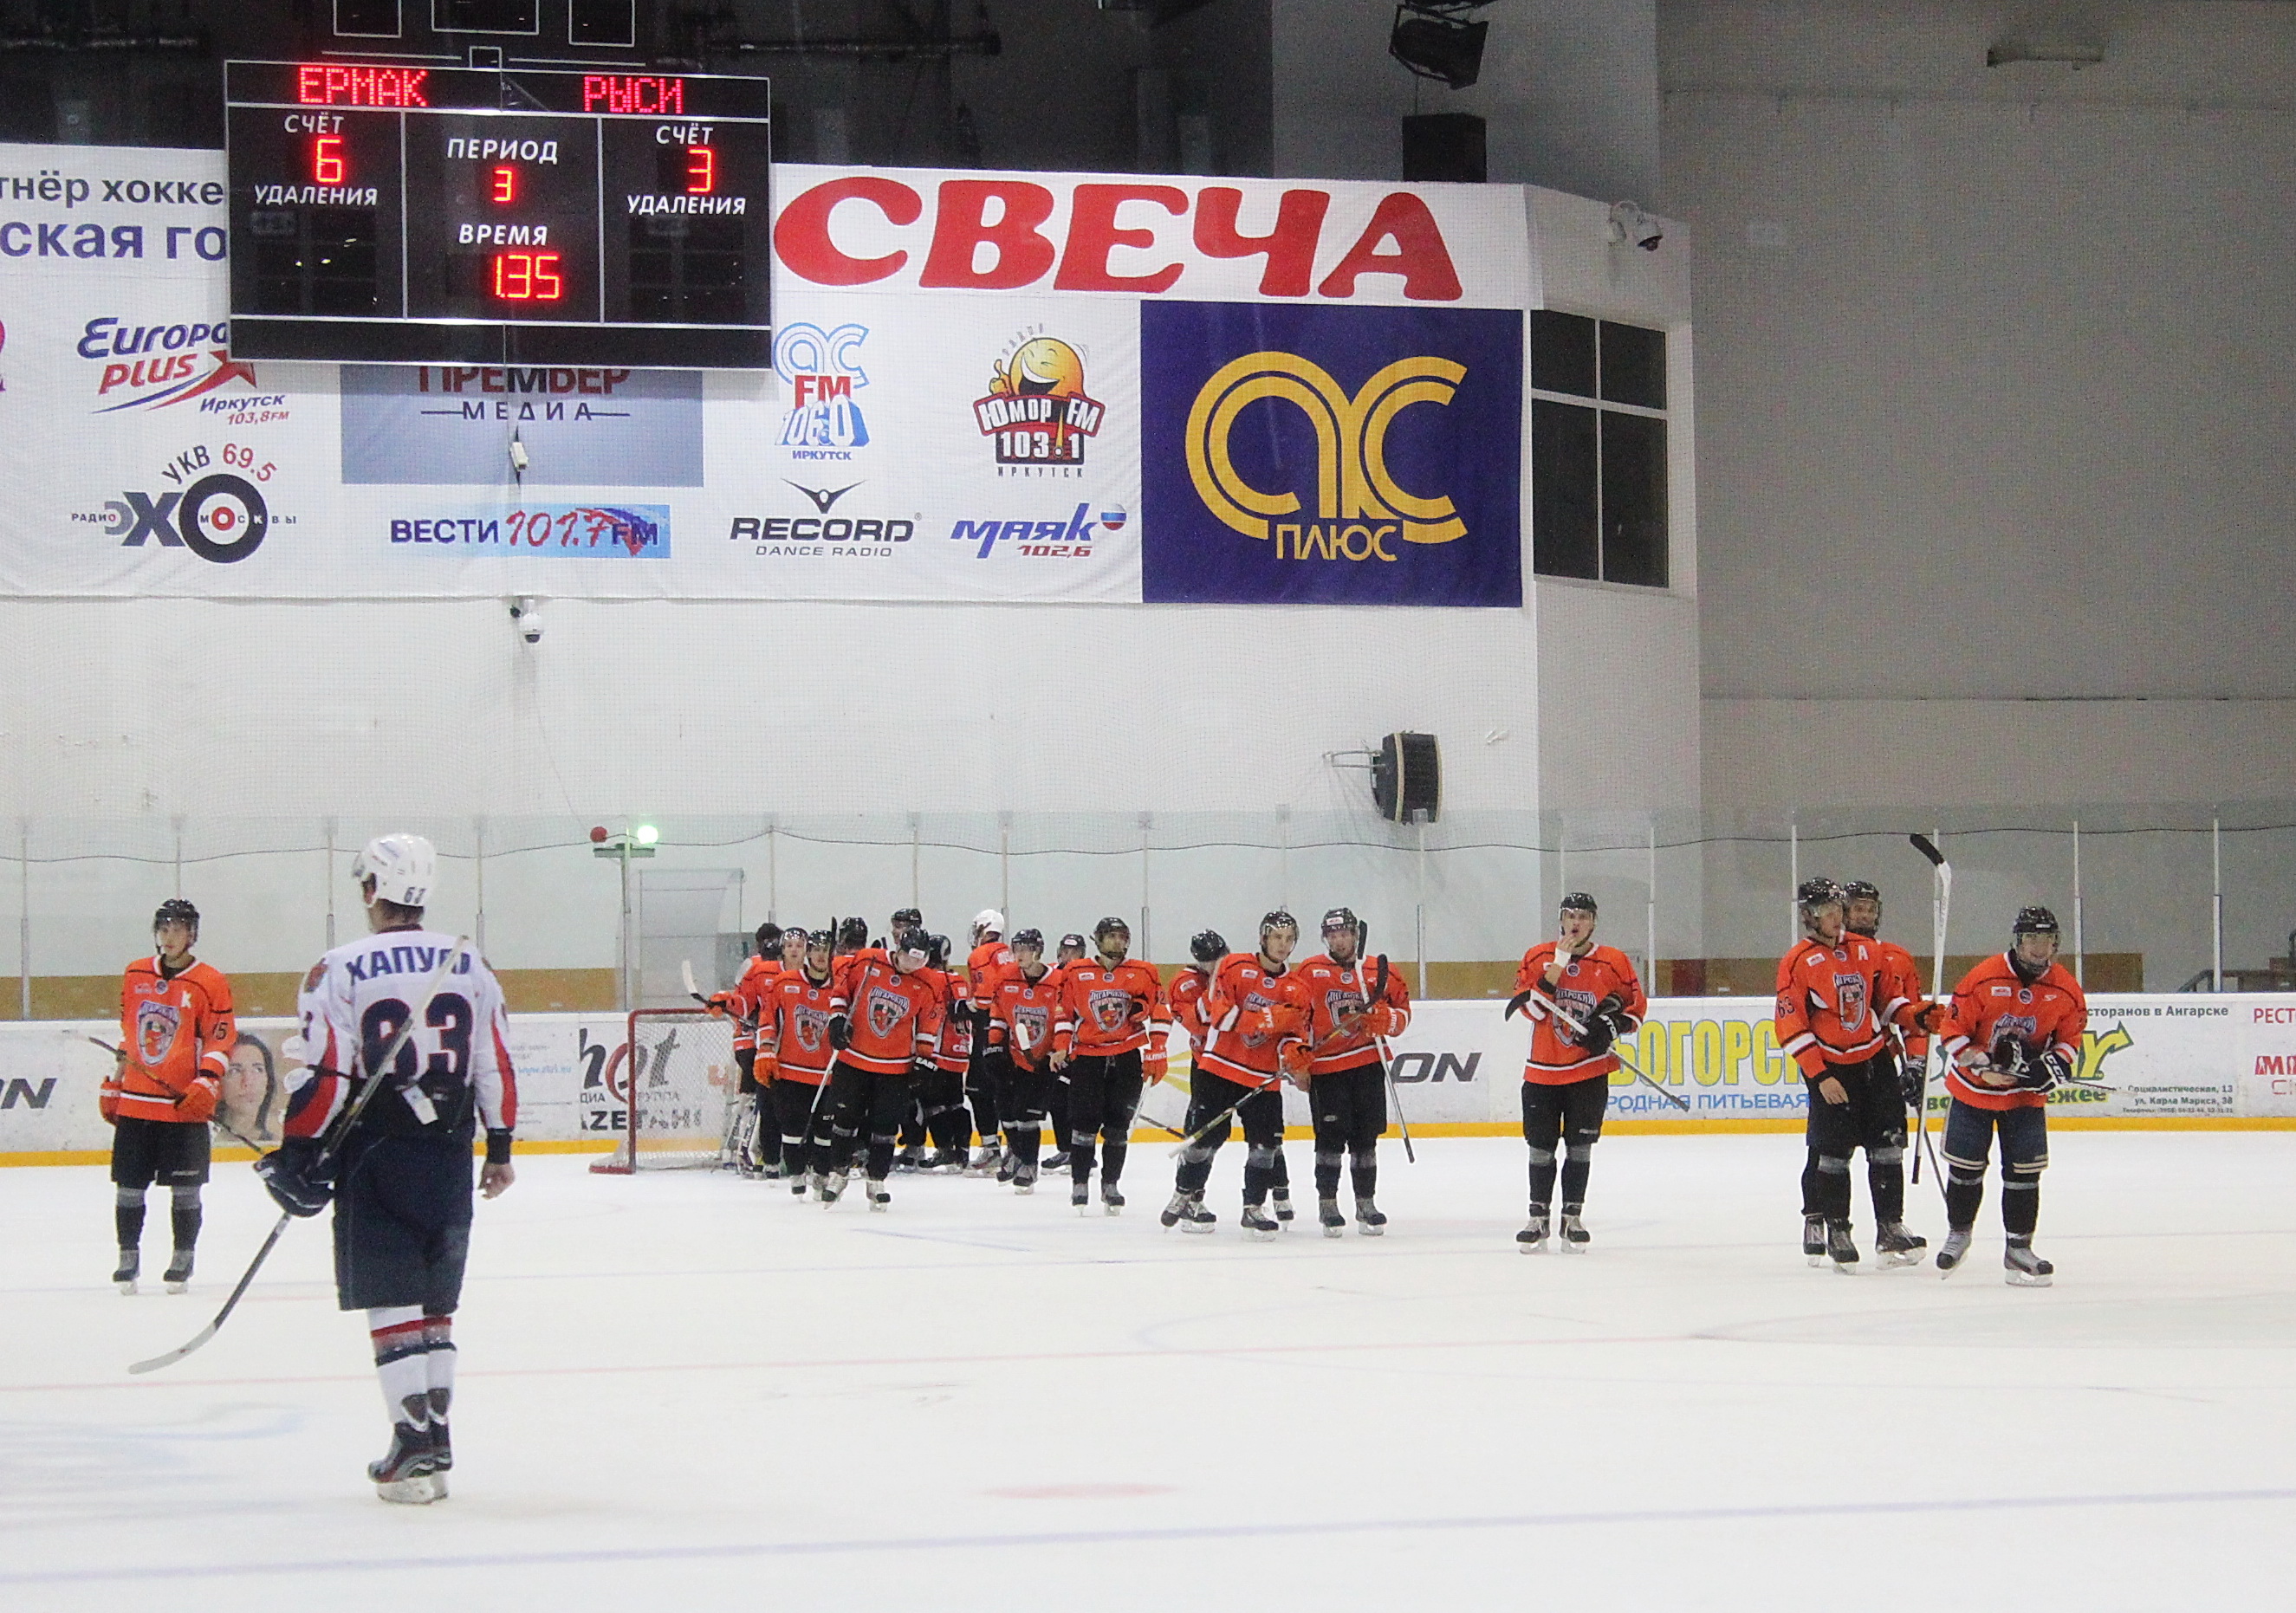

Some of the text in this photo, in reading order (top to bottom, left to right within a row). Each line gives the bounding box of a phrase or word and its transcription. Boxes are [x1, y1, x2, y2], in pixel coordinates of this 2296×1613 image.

[298, 68, 428, 106] ЕРМАК
[583, 75, 684, 115] РЫСИ
[284, 113, 344, 134] СЧЁТ
[656, 124, 714, 145] СЧЁТ
[315, 138, 344, 183] 6
[447, 138, 559, 165] ПЕРИОД
[687, 148, 713, 193] 3
[255, 185, 378, 206] УДАЛЕНИЯ
[493, 169, 513, 203] 3
[627, 194, 746, 217] УДАЛЕНИЯ
[458, 223, 548, 245] ВРЕМЯ
[773, 176, 1464, 303] СВЕЧА
[794, 374, 852, 410] FM
[200, 394, 286, 414] Иркутск
[462, 401, 593, 421] МЕДИА
[1066, 398, 1100, 432] FM
[161, 443, 277, 485] УКВ 69.5
[792, 450, 852, 461] ИРКУТСК
[997, 466, 1083, 478] ИРКУТСК
[71, 513, 116, 523] РАДИО
[391, 519, 499, 544] ВЕСТИ
[611, 521, 658, 546] FM
[1276, 521, 1399, 565] ПЛЮС
[756, 546, 892, 558] DANCE RADIO
[1016, 545, 1093, 560] 102,6
[1858, 944, 1869, 962] A
[1777, 996, 1795, 1019] 63
[2155, 1007, 2162, 1016] в
[2166, 1005, 2228, 1018] Ангарске
[1698, 1093, 1810, 1110] ПИТЬЕВАЯ
[2150, 1097, 2178, 1106] Карла
[2222, 1097, 2233, 1105] 38
